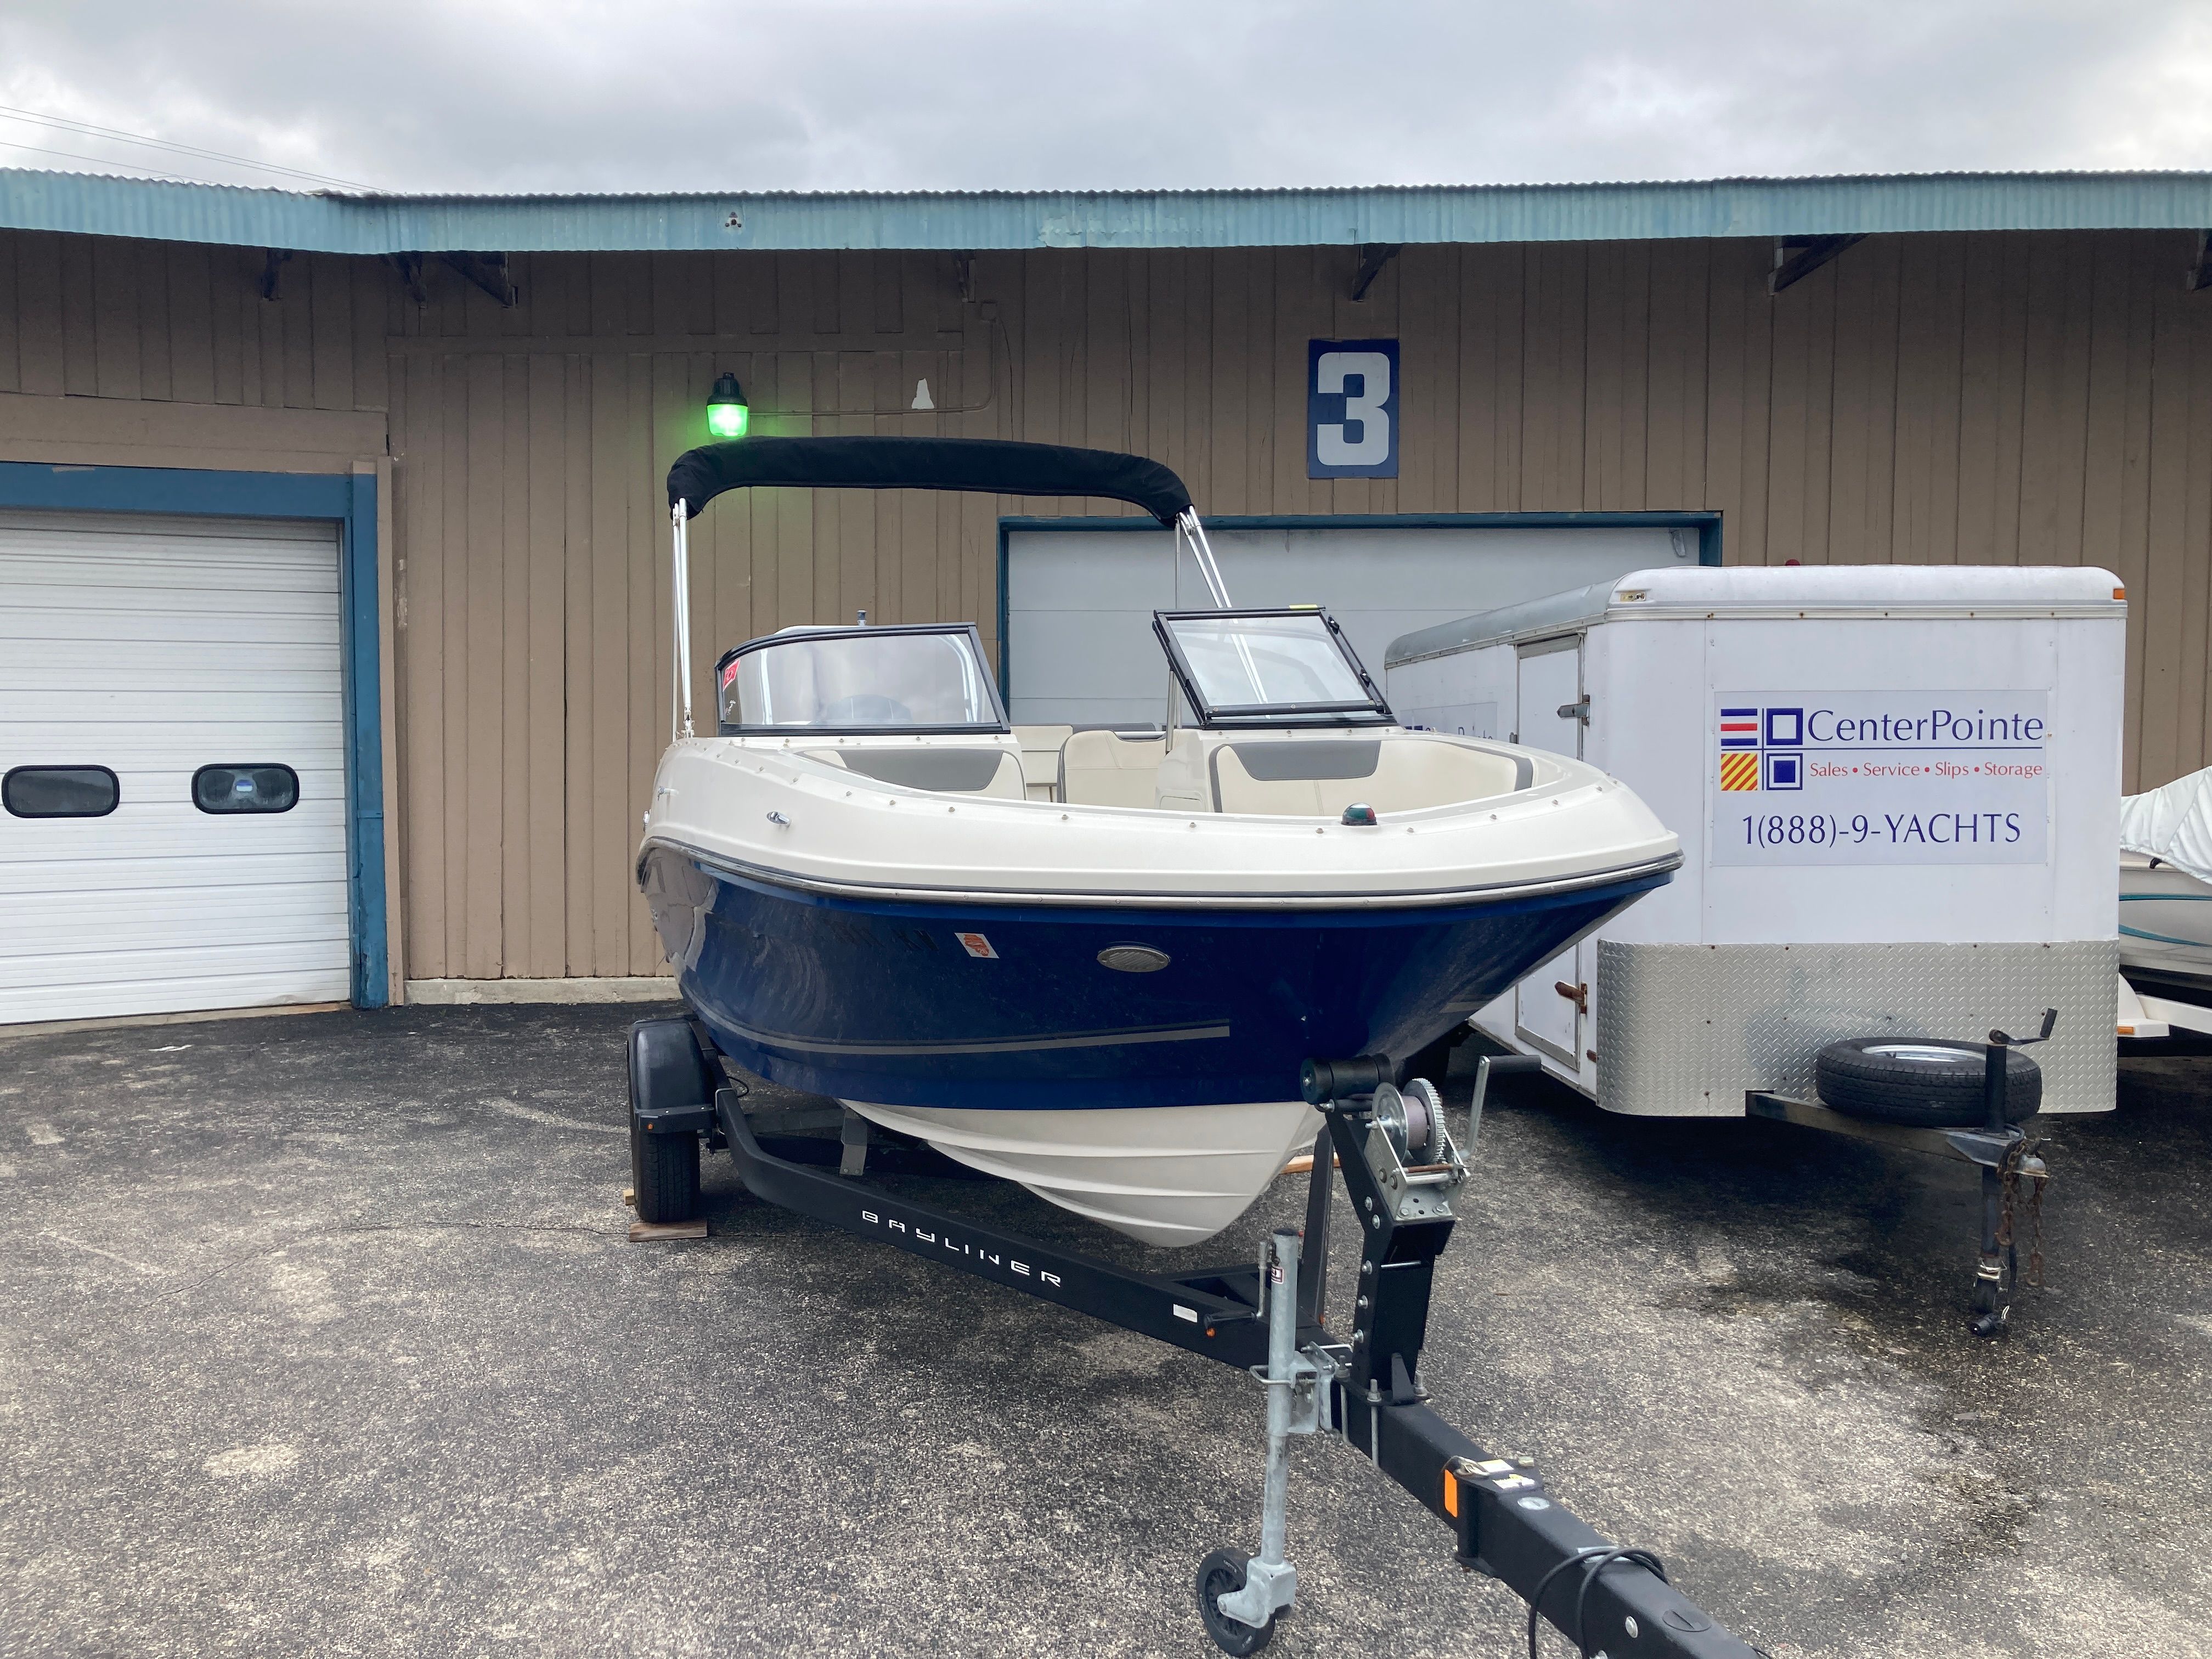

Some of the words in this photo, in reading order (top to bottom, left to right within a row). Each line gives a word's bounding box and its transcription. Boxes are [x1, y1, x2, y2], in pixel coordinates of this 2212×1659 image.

[1317, 352, 1390, 466] 3
[1808, 709, 2043, 742] CenterPointe
[1810, 761, 1848, 777] Sales
[1863, 761, 1920, 776] Service
[1934, 760, 1969, 779] Slips
[1984, 760, 2042, 779] Storage
[1742, 812, 2021, 849] 1(888)-9-YACHTS
[861, 1210, 1062, 1288] BAYLINER
